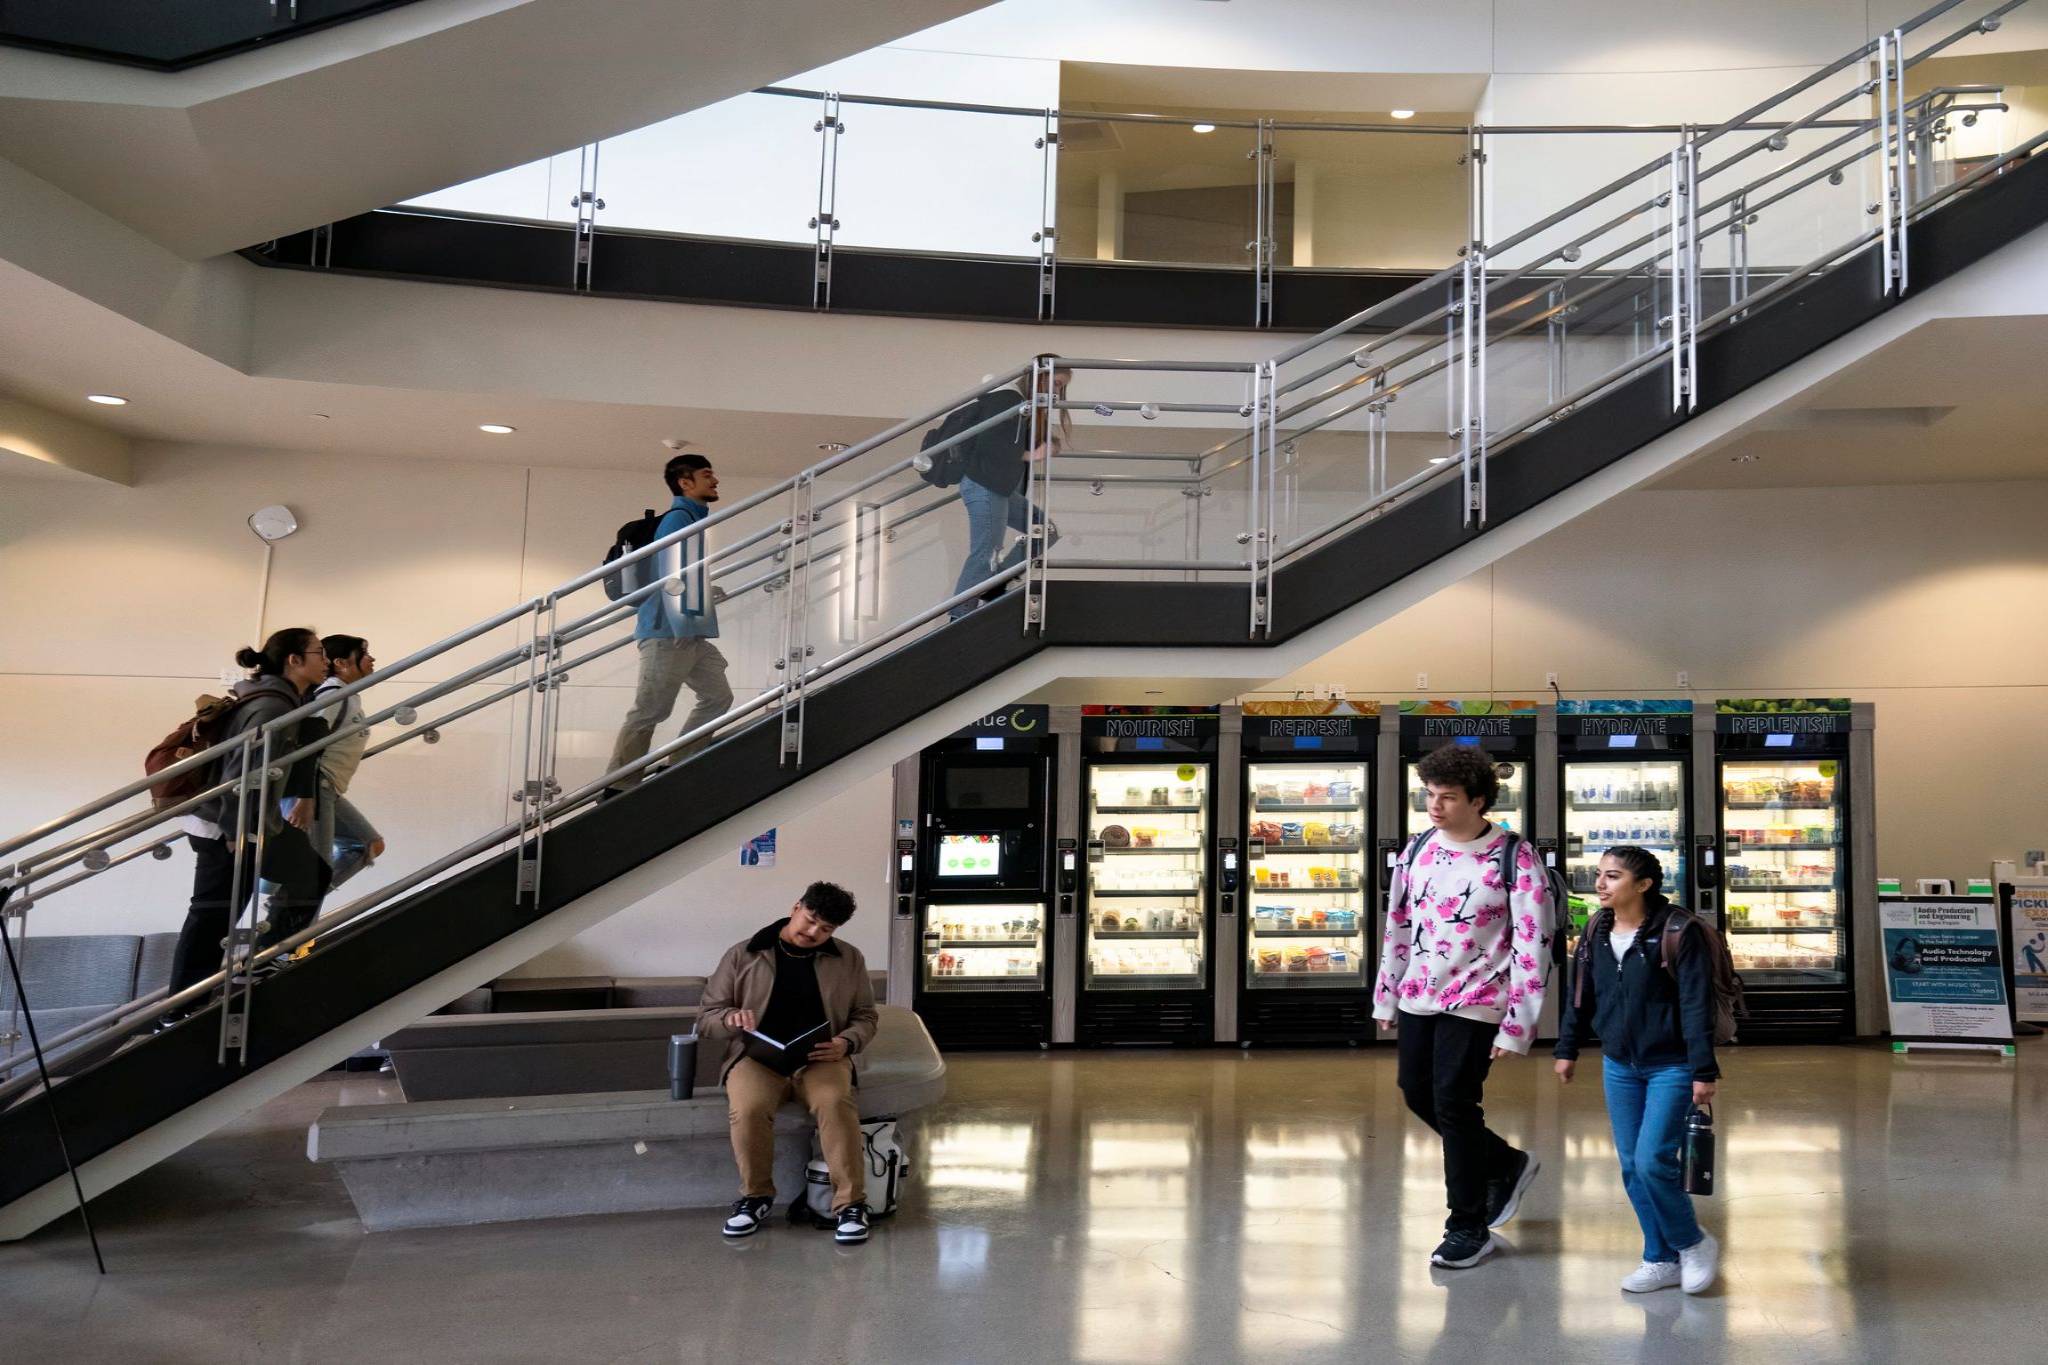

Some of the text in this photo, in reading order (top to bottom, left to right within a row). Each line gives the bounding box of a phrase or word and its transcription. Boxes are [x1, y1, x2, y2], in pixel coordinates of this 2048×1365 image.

[1106, 719, 1195, 737] NOURISH
[1270, 719, 1352, 737] REFRESH
[1425, 718, 1511, 736] HYDRATE
[1581, 717, 1667, 736] HYDRATE
[1732, 716, 1837, 734] REPLENISH
[1918, 906, 1975, 914] Audio Production
[1947, 948, 1993, 957] Technology
